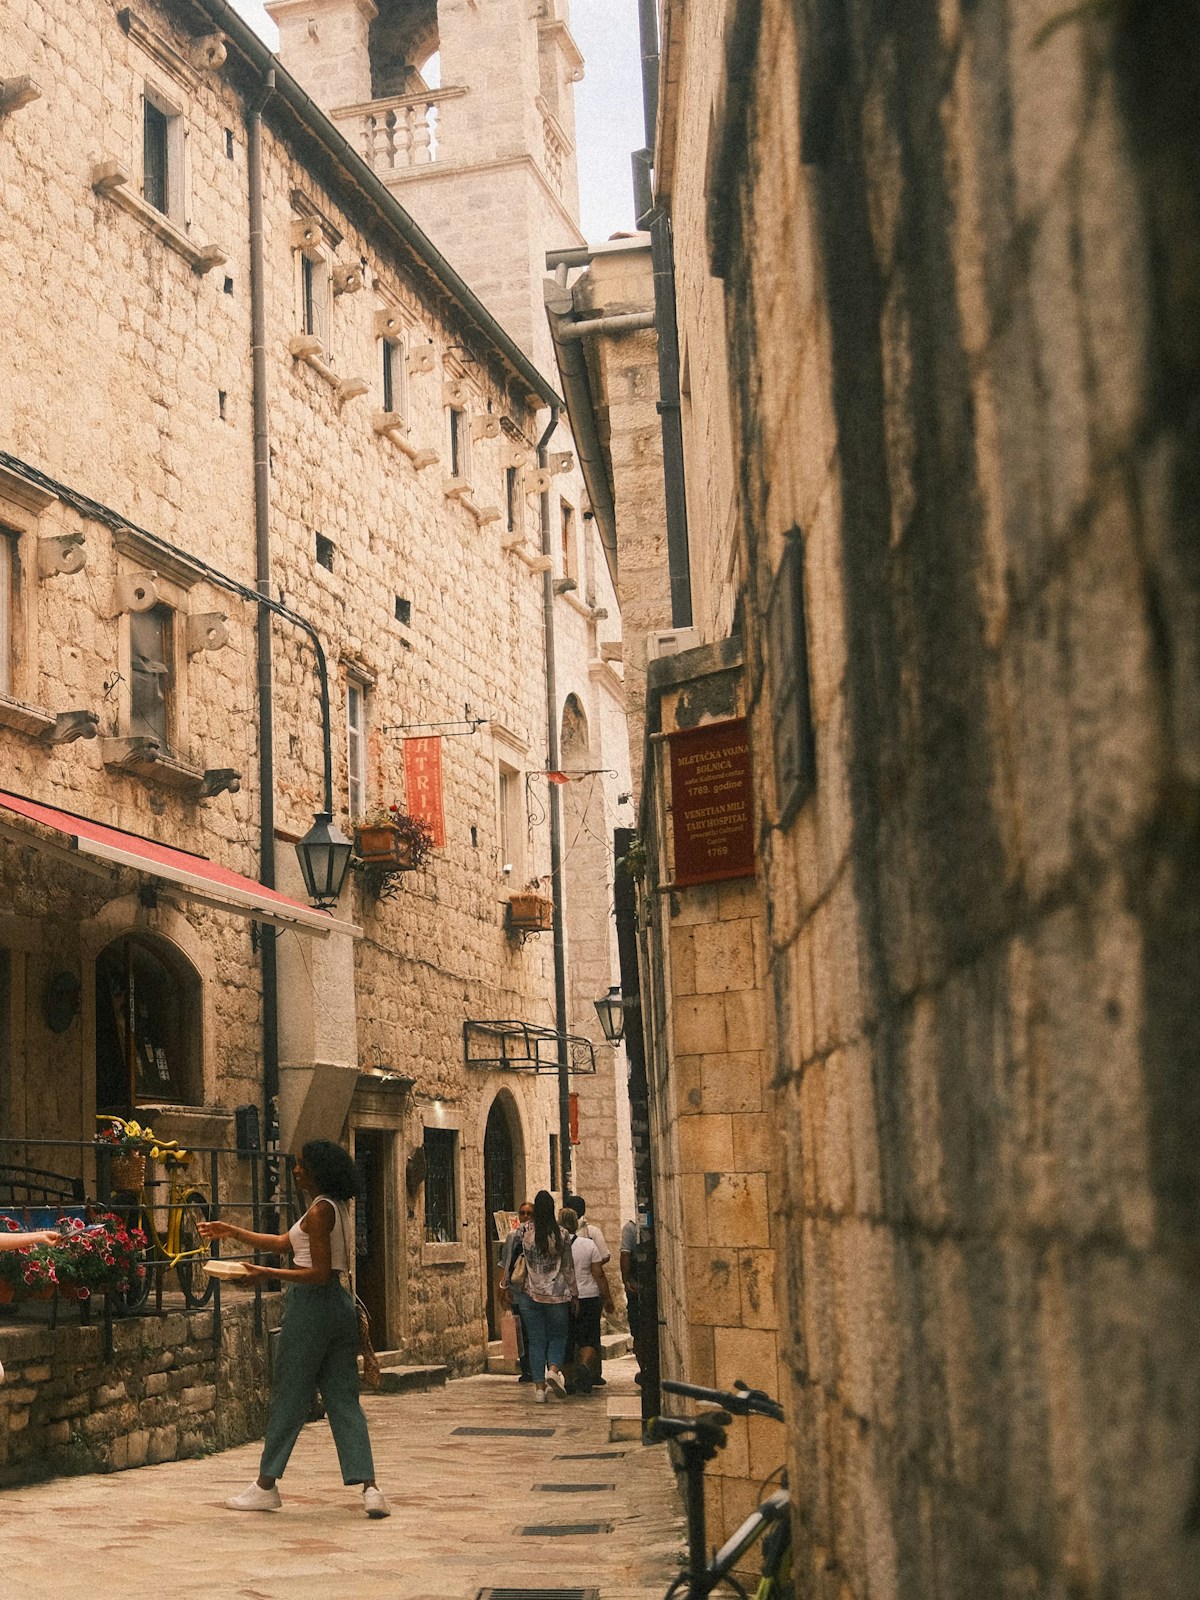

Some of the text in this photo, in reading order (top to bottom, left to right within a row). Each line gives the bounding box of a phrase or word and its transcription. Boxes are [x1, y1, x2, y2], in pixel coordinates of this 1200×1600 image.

[722, 745, 749, 757] VOJNA
[696, 760, 732, 774] BOLNICA
[688, 780, 743, 797] 1769. godine
[684, 805, 726, 819] VENETIAN
[707, 813, 747, 827] HOSPITAL
[707, 846, 728, 857] 1769
